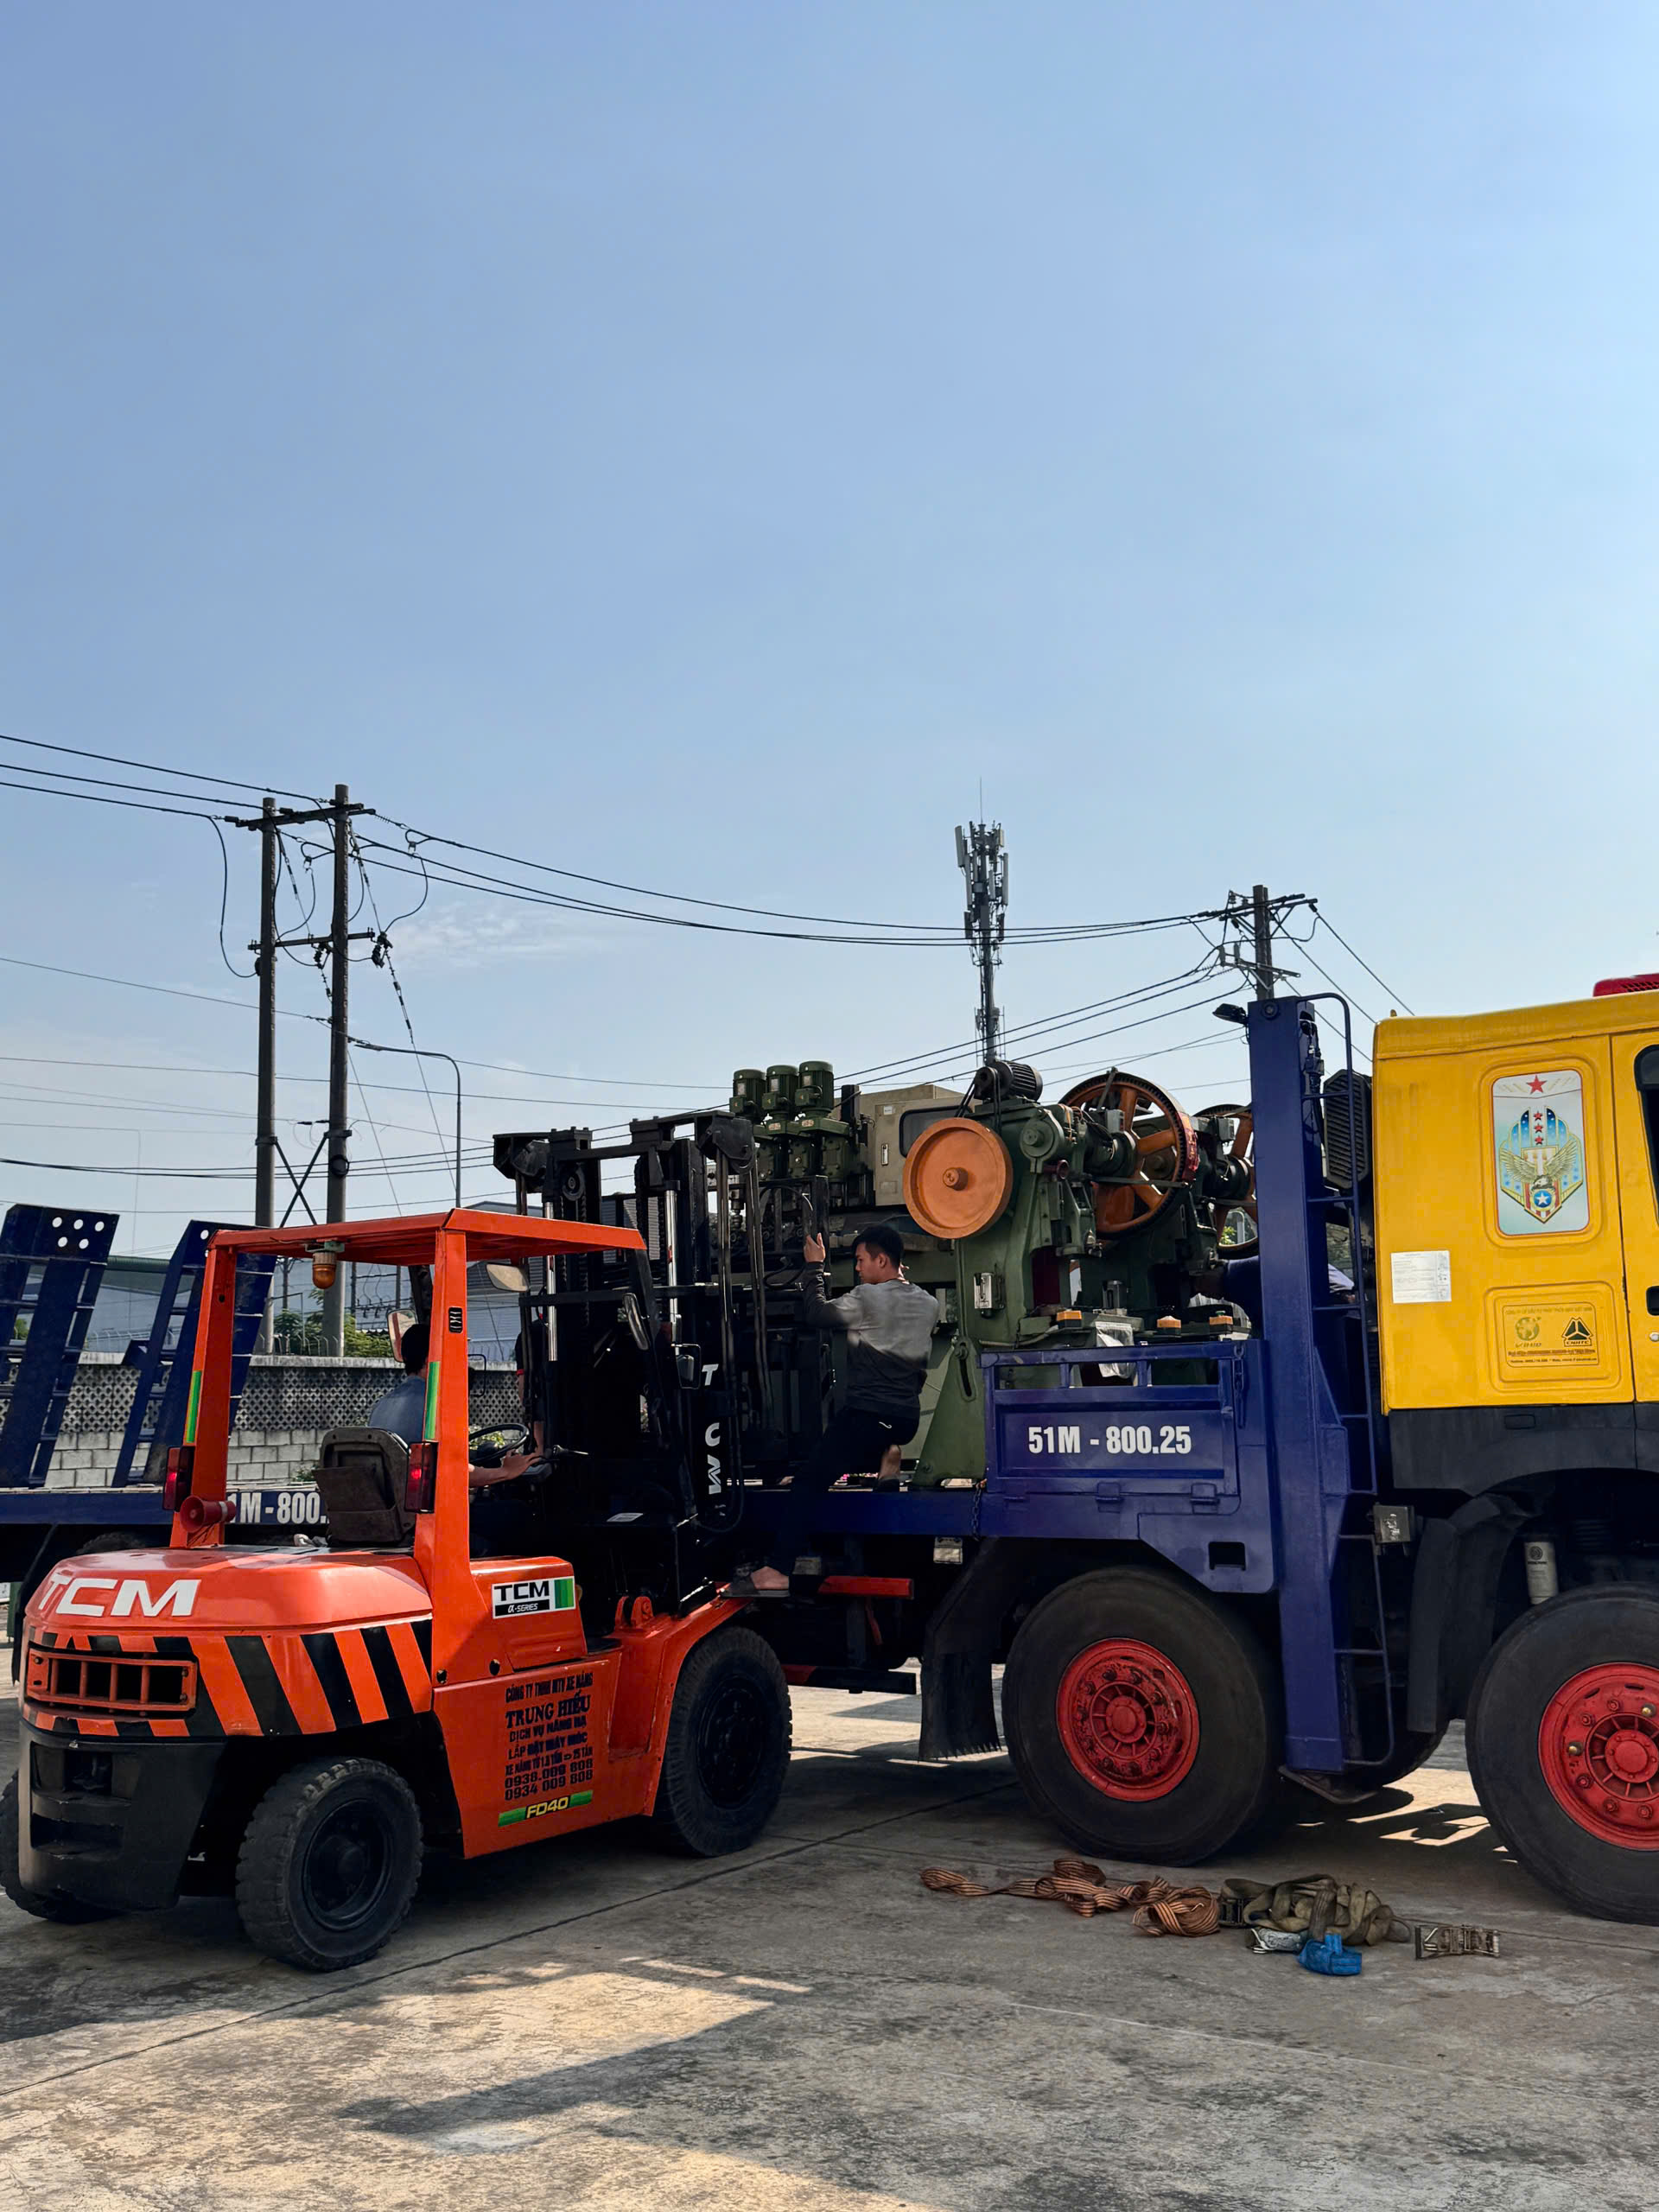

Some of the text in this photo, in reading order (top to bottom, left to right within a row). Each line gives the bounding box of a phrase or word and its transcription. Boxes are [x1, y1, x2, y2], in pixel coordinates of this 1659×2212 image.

[1028, 1426, 1080, 1453] 51M
[1106, 1426, 1192, 1454] 800.25
[276, 1492, 329, 1524] 800.
[38, 1573, 201, 1618] TCM
[494, 1580, 550, 1602] TCM
[505, 1689, 591, 1729] TRUNG HIẾU
[510, 1727, 531, 1743] DỊCH
[532, 1725, 545, 1738] VỤ
[546, 1718, 572, 1734] NÂNG
[507, 1744, 526, 1759] LẮP
[570, 1758, 594, 1773] 808
[505, 1769, 594, 1802] 0934 009 808
[526, 1796, 569, 1819] FD40
